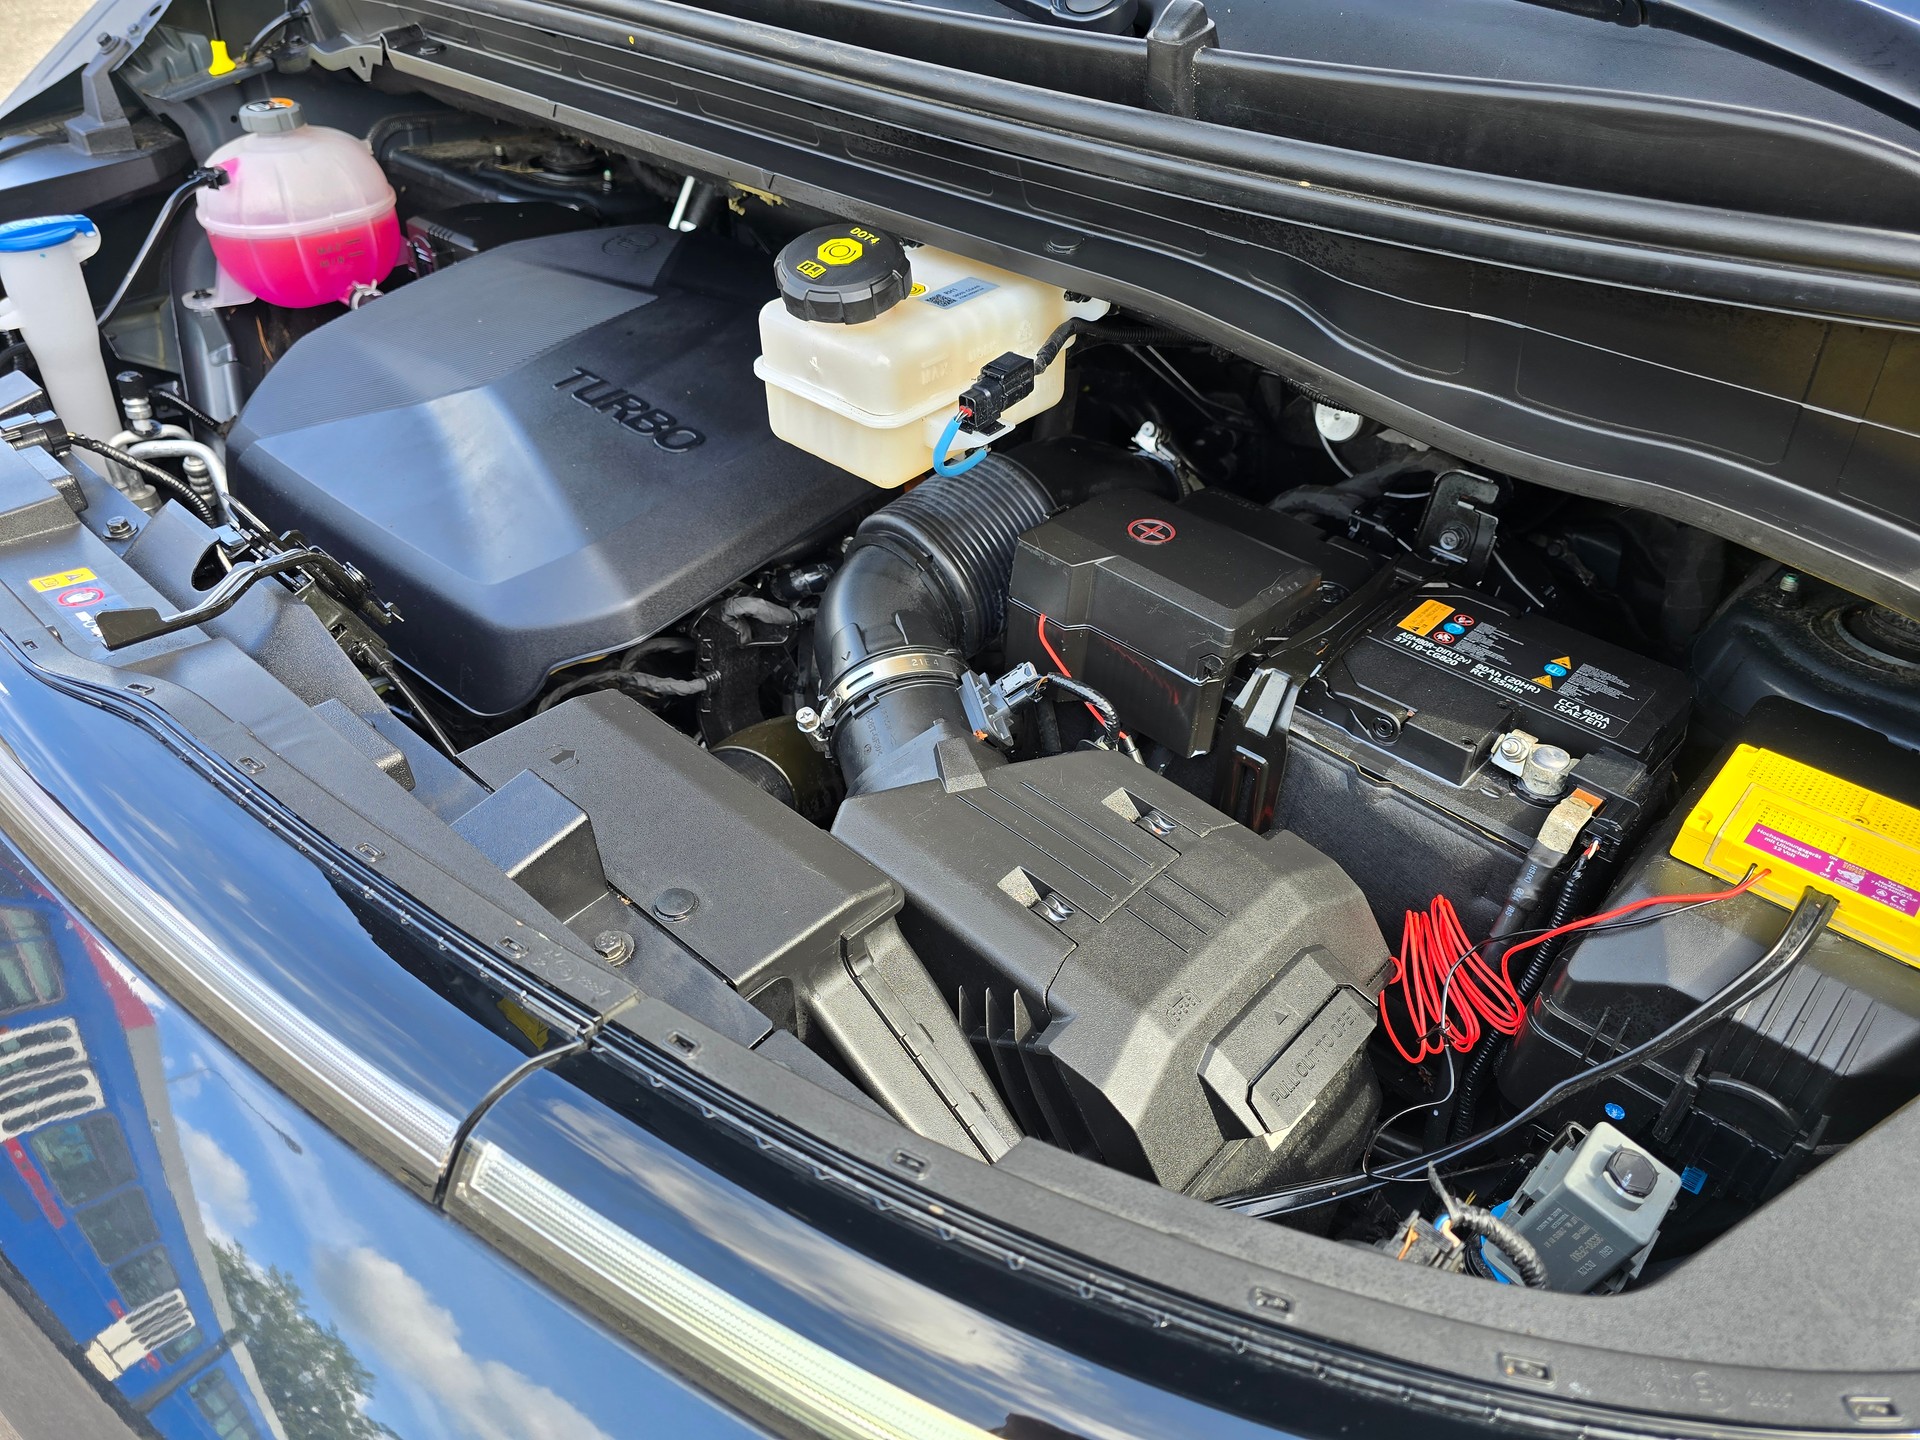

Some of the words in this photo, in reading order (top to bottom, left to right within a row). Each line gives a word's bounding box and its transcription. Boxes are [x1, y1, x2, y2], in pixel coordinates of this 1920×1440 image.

[849, 226, 881, 246] DOT4
[552, 366, 706, 454] TURBO
[1469, 667, 1487, 678] RC
[1487, 674, 1524, 694] 155min
[1474, 663, 1503, 678] 80Ah
[1503, 675, 1541, 694] (20HR)
[1558, 698, 1580, 712] CCA
[1582, 708, 1611, 725] 800A
[1756, 828, 1822, 860] Hochspannungsgerät
[1763, 836, 1776, 845] mit
[1776, 841, 1810, 859] Ultraschall
[1782, 849, 1796, 859] Volt
[1524, 864, 1538, 884] HS(K)
[1819, 871, 1831, 879] OFF
[1505, 904, 1516, 917] IBS
[1270, 1074, 1301, 1107] PULL
[1295, 1048, 1320, 1078] OUT
[1314, 1033, 1335, 1054] TO
[1330, 1005, 1361, 1038] OPEN
[1577, 1260, 1597, 1277] DC12V
